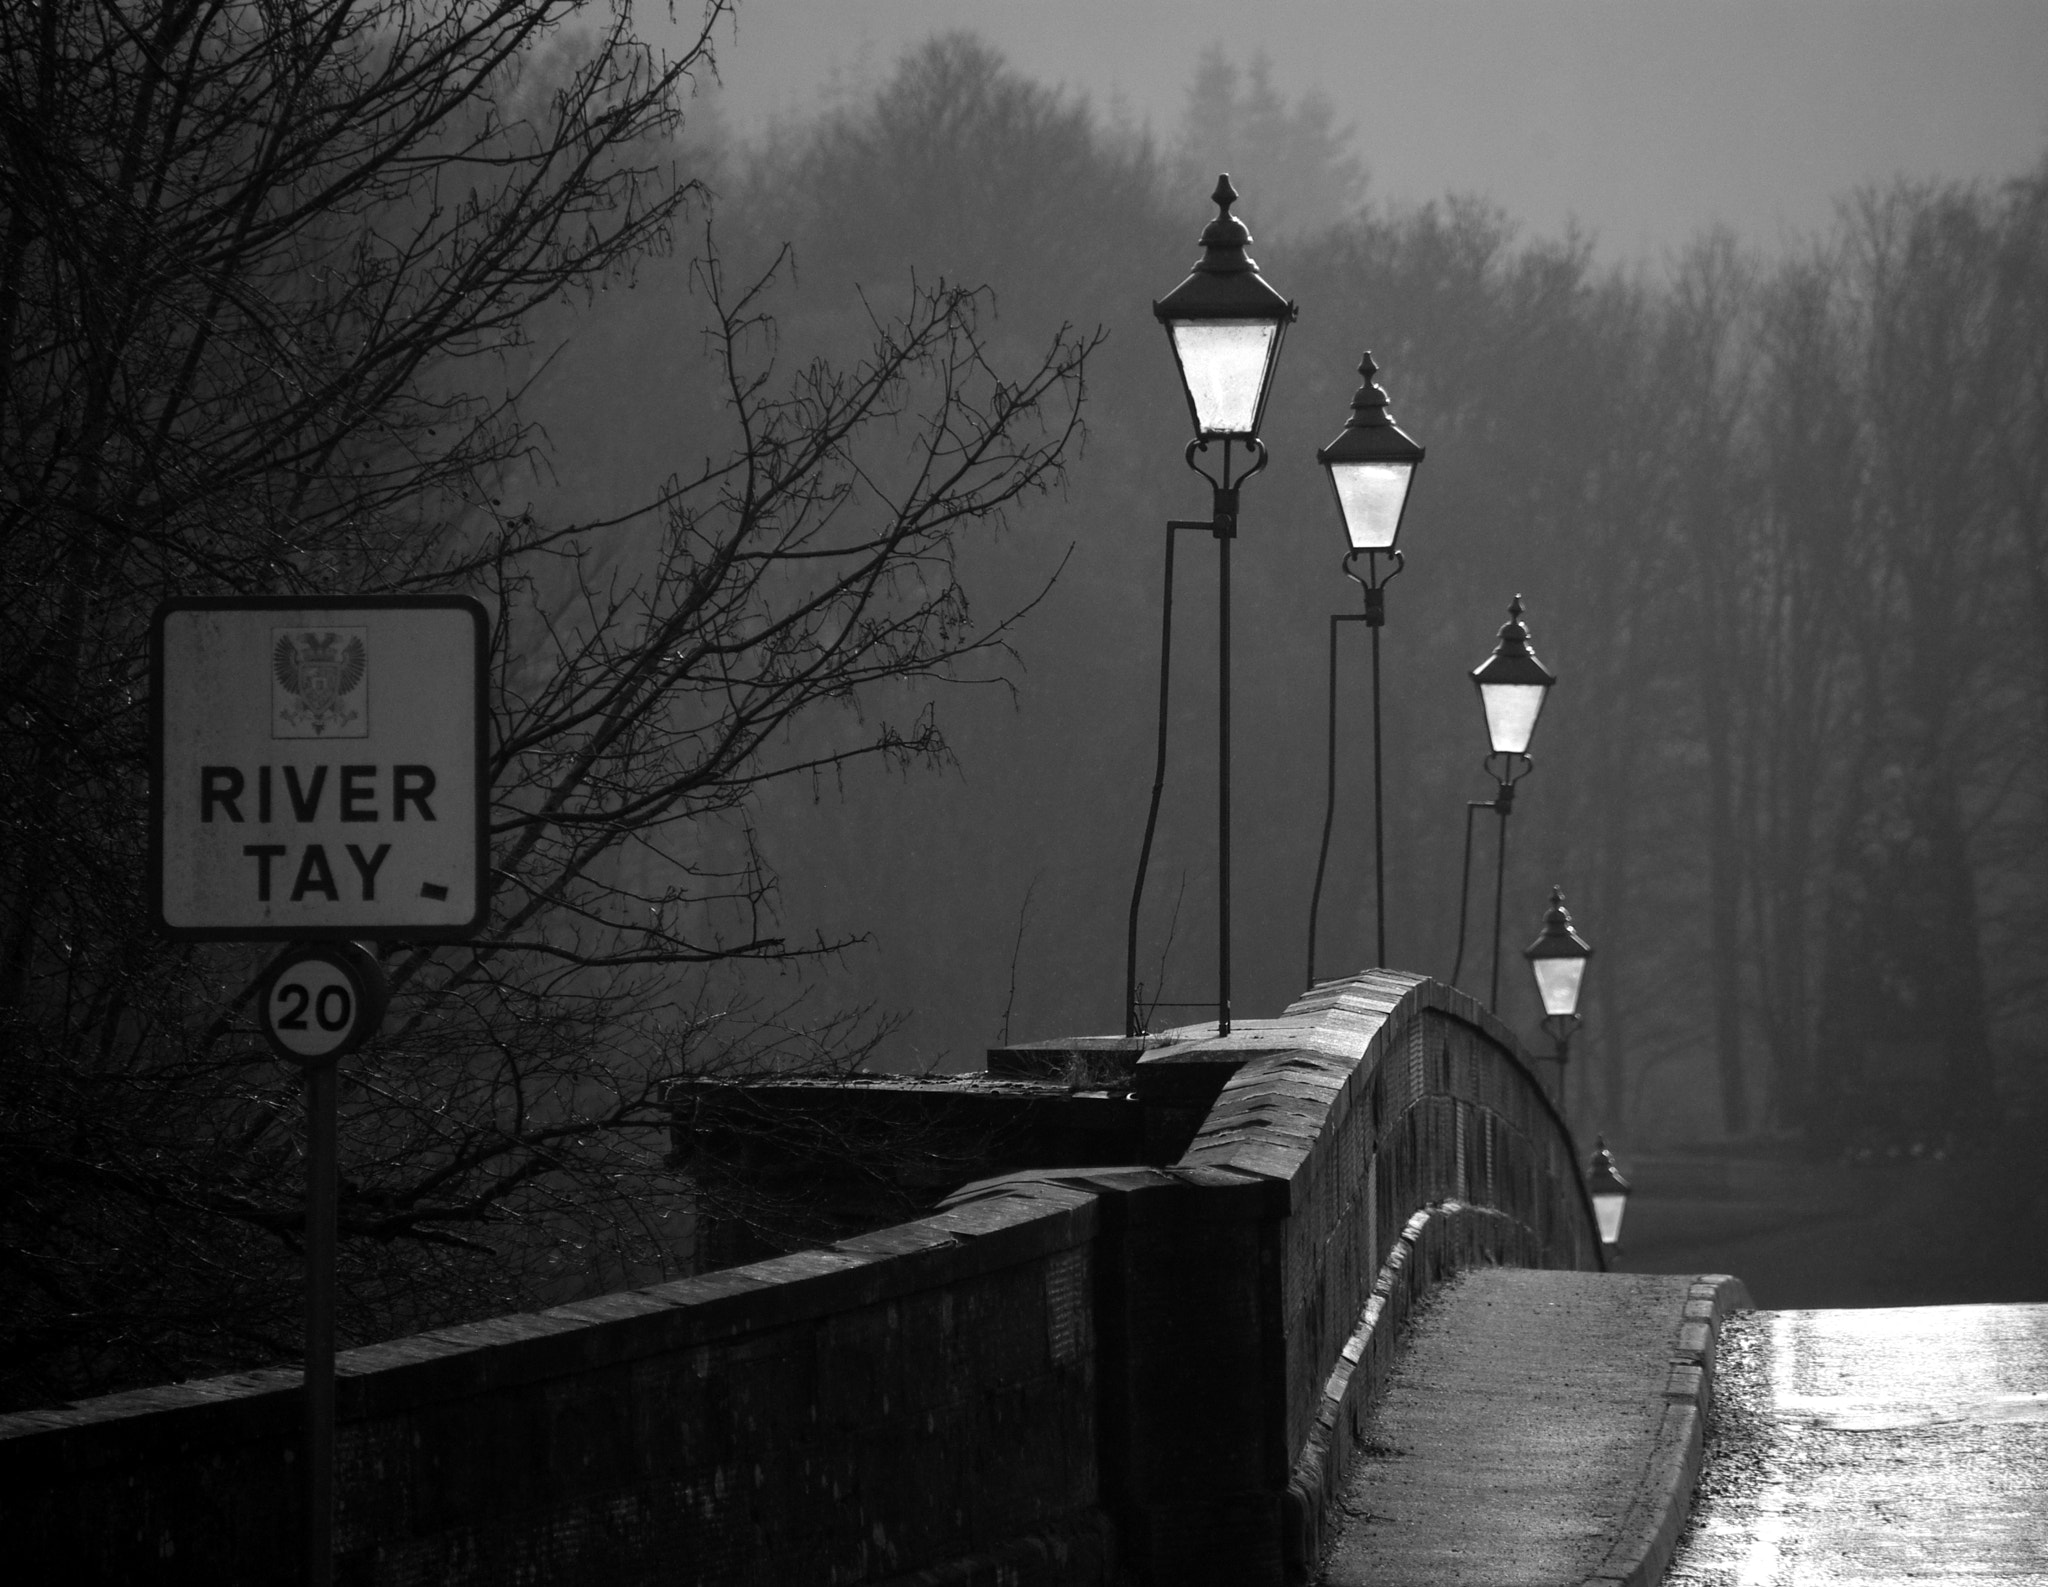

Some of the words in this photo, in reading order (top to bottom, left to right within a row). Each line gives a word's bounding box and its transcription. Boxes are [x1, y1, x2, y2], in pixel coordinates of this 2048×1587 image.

[200, 765, 437, 823] RIVER
[243, 844, 391, 902] TAY
[276, 984, 351, 1032] 20
